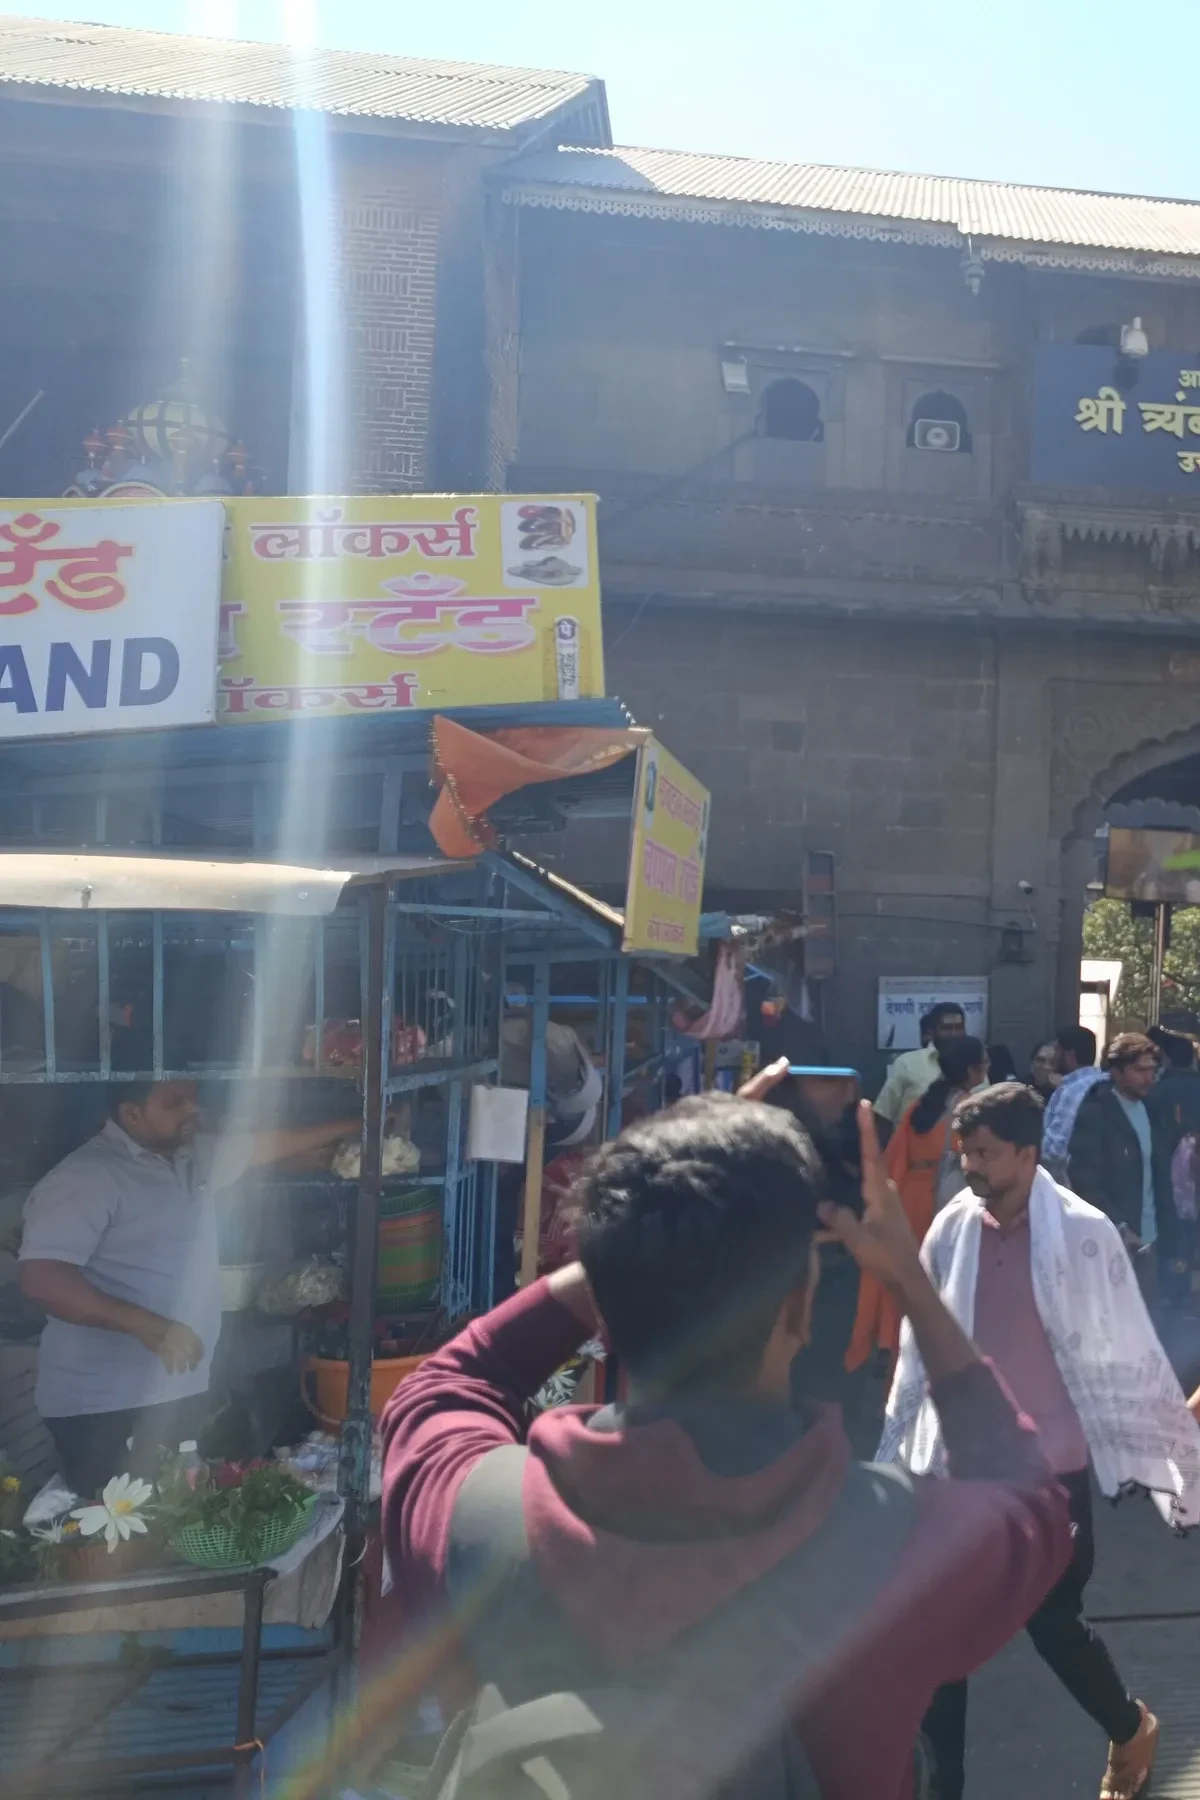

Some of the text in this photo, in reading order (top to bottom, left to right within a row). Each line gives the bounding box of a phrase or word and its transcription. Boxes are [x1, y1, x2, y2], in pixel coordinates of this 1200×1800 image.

[1074, 386, 1127, 435] श्री
[250, 506, 478, 559] लॉकर्स
[0, 637, 181, 714] AND
[217, 672, 419, 713] ॉकर्स
